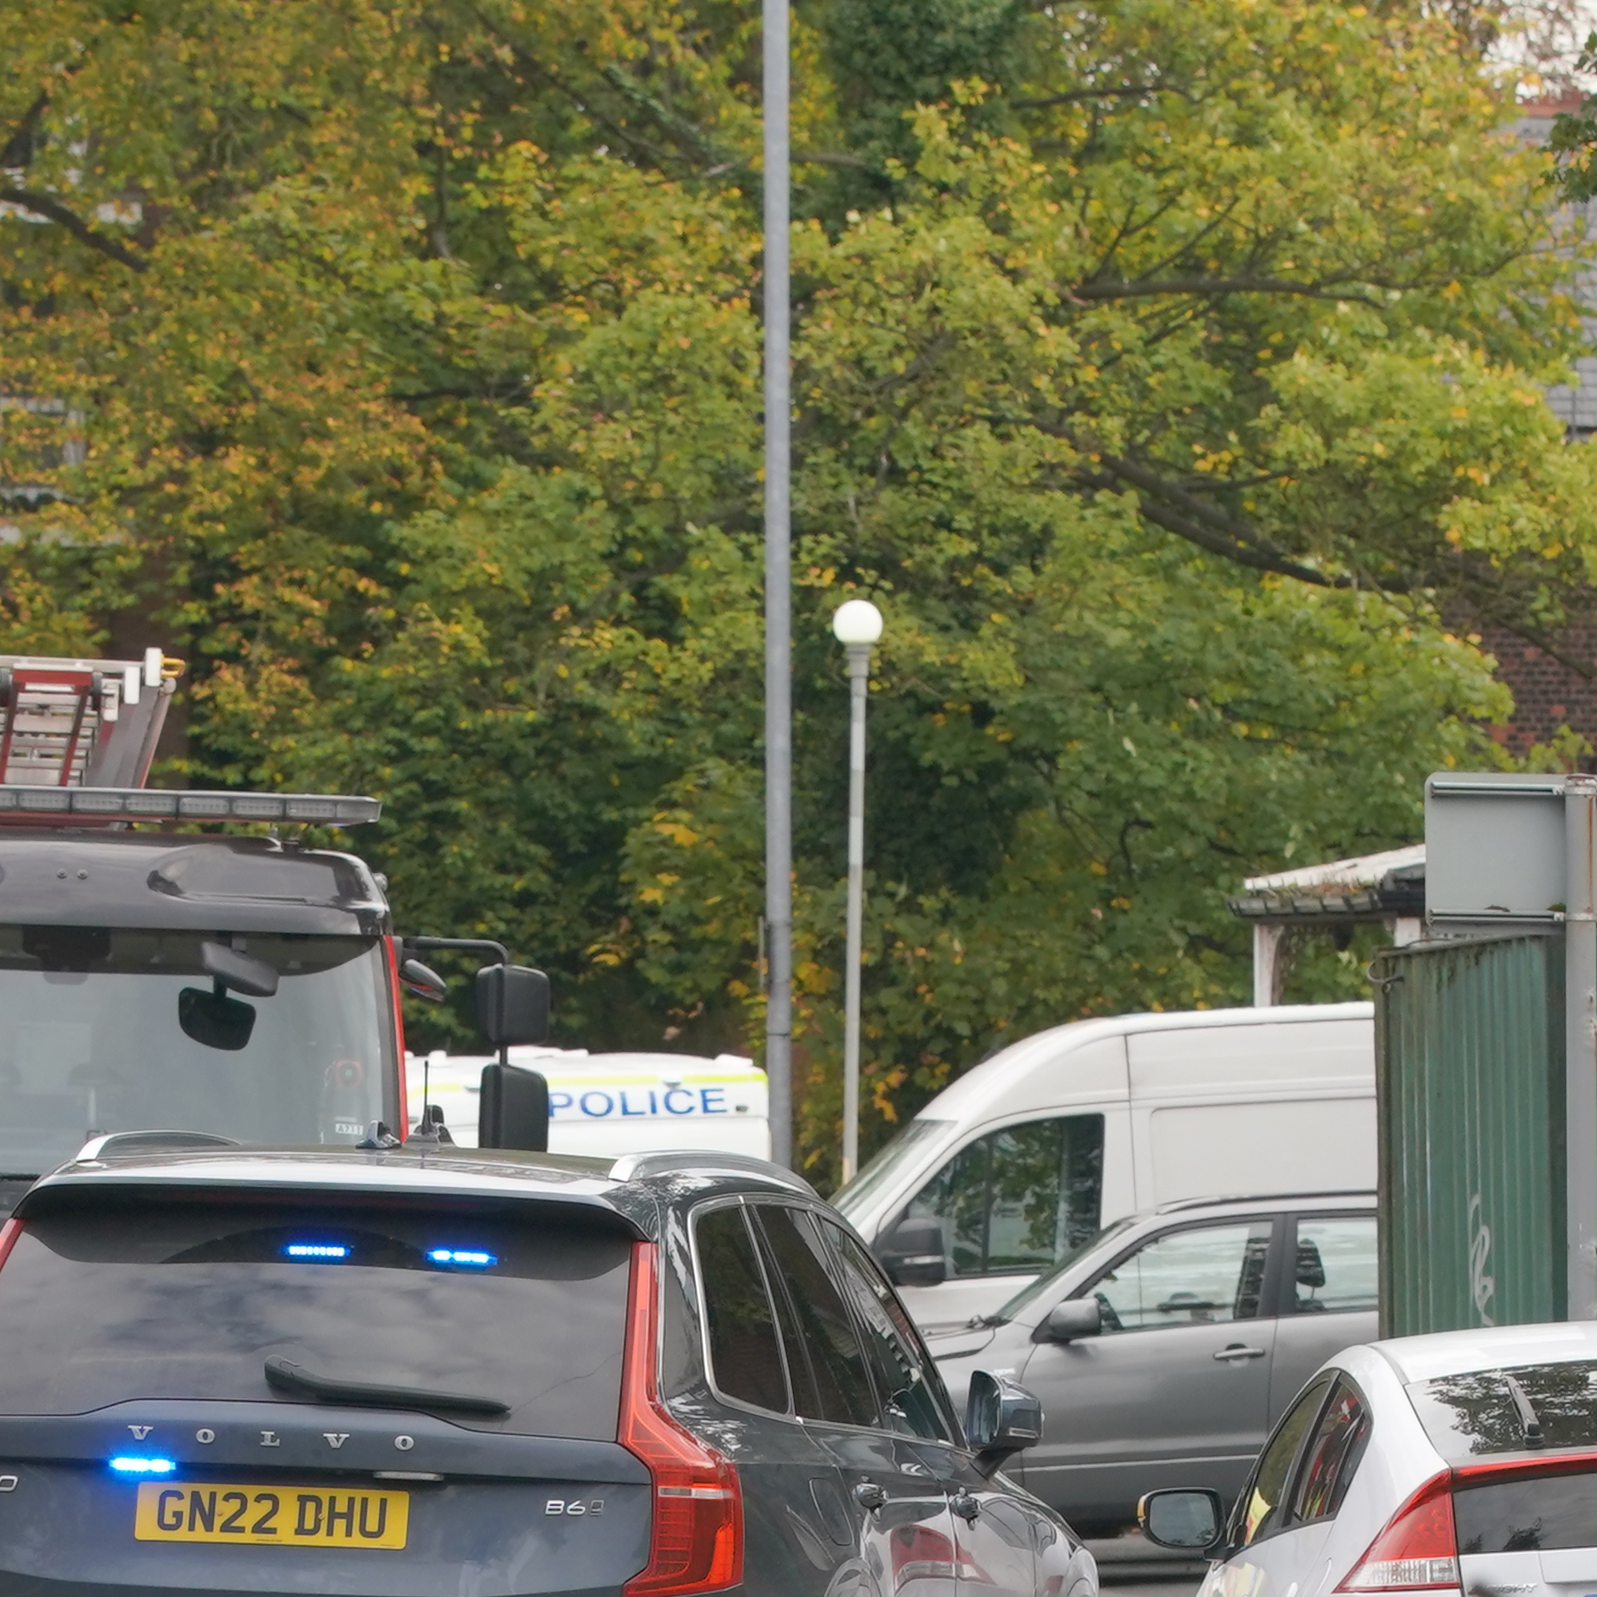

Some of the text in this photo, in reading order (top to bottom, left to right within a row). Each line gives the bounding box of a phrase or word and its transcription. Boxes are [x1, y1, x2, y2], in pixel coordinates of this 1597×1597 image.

[548, 1088, 728, 1118] POLICE
[128, 1424, 415, 1451] VOLVO
[156, 1489, 388, 1540] GN22 DHU
